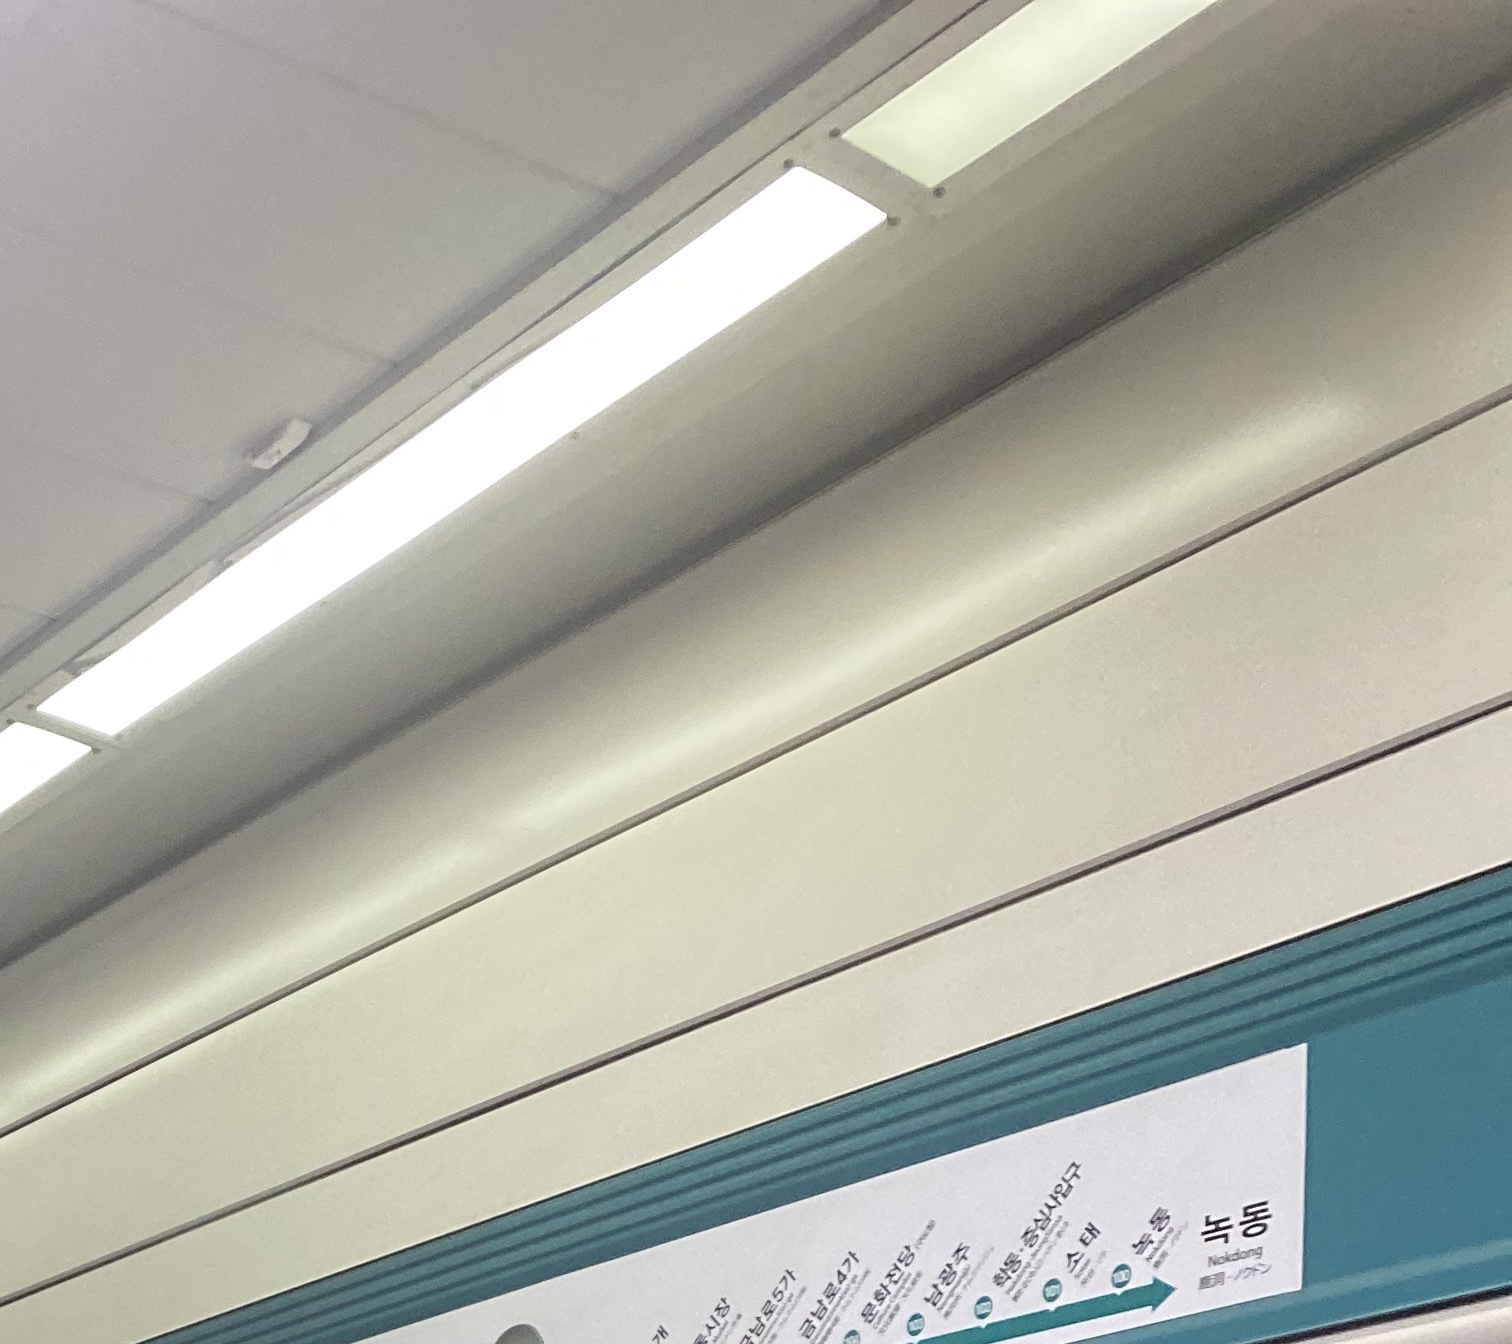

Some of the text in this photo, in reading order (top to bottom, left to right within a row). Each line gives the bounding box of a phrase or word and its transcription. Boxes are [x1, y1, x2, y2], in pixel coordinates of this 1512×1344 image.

[1066, 1202, 1101, 1274] 소태
[1131, 1206, 1171, 1256] 녹동
[1201, 1200, 1272, 1243] 녹동
[861, 1245, 916, 1324] 문화전당
[923, 1242, 970, 1307] 남광주
[1207, 1246, 1263, 1267] Nokdong
[798, 1250, 860, 1339] 금남로4가
